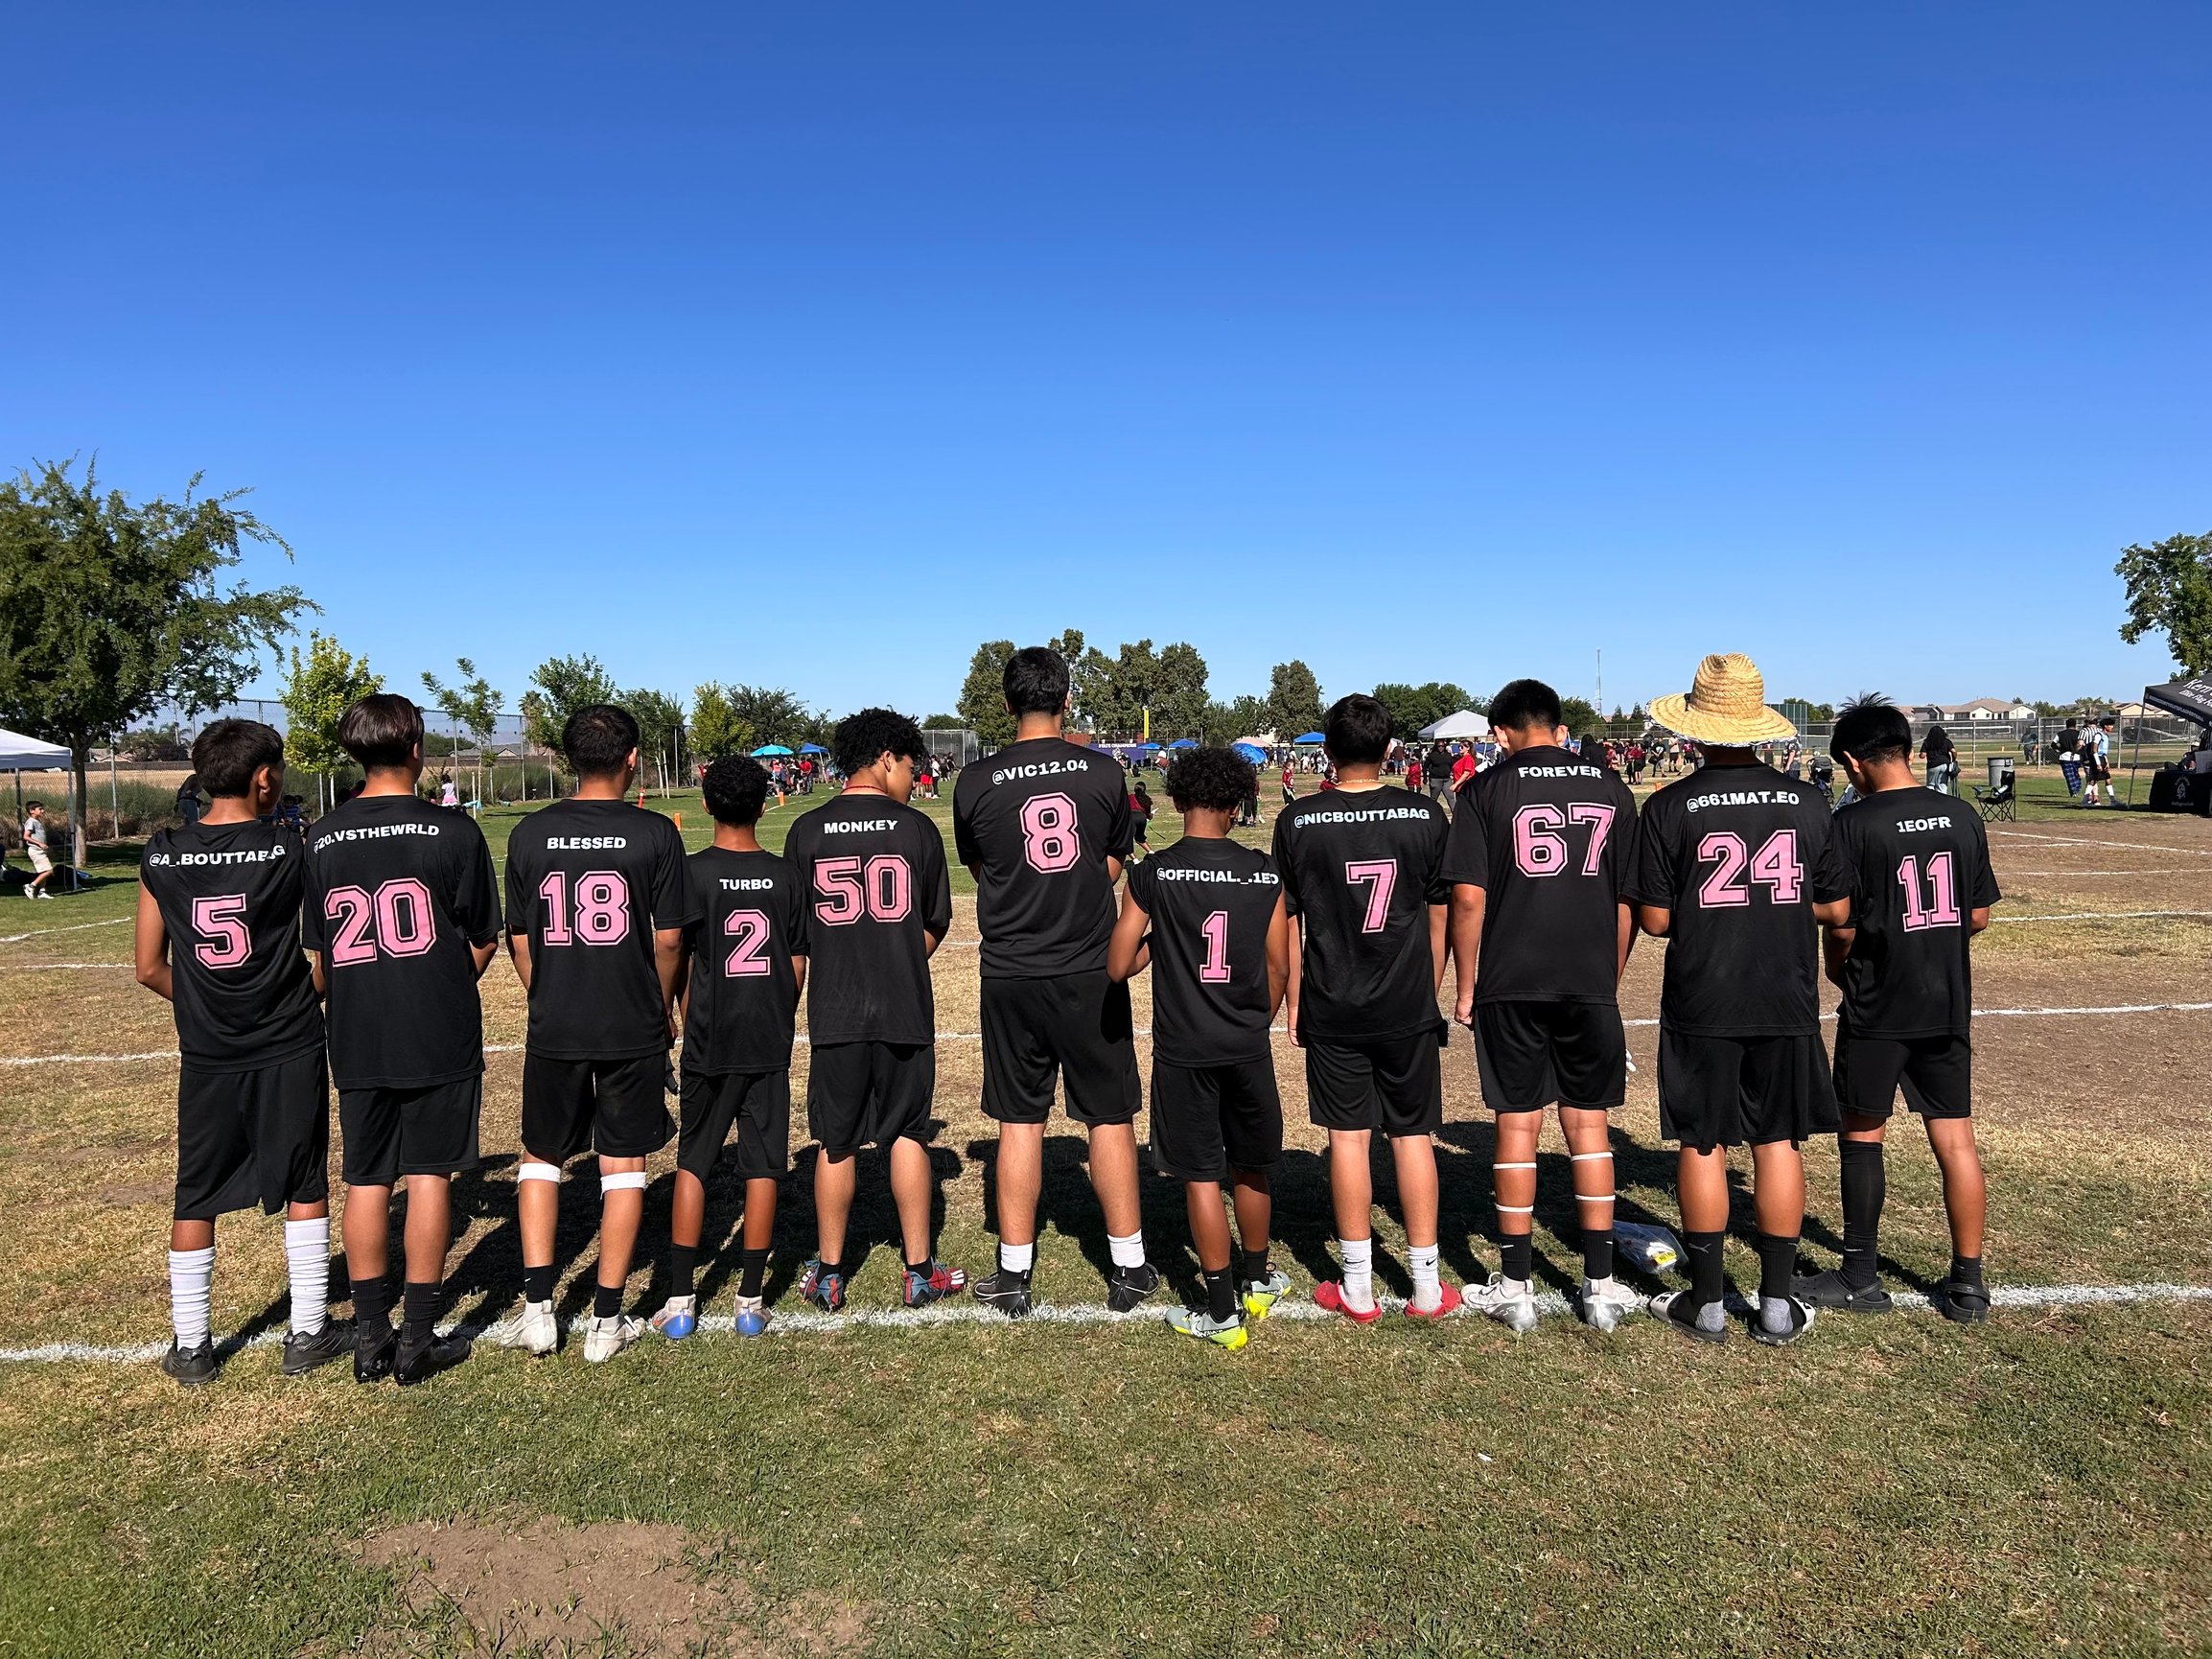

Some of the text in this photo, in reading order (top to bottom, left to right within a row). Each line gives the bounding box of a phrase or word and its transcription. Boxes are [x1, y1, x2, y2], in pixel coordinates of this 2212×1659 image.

[992, 759, 1088, 785] @VIC12.04
[1518, 765, 1603, 780] FOREVER
[547, 836, 627, 851] BLESSED
[824, 819, 898, 834] MONKEY
[1018, 791, 1082, 875] 8
[1294, 808, 1431, 829] @NICBOUTTABAG
[1512, 803, 1617, 877] 67
[719, 877, 774, 891] TURBO
[813, 853, 912, 926] 50
[1344, 858, 1398, 934] 7
[1697, 829, 1805, 909] 24
[1897, 851, 1962, 933] 11
[192, 893, 253, 970] 5
[324, 876, 437, 968] 20
[539, 870, 630, 946] 18
[724, 908, 771, 978] 2
[1199, 910, 1232, 984] 1
